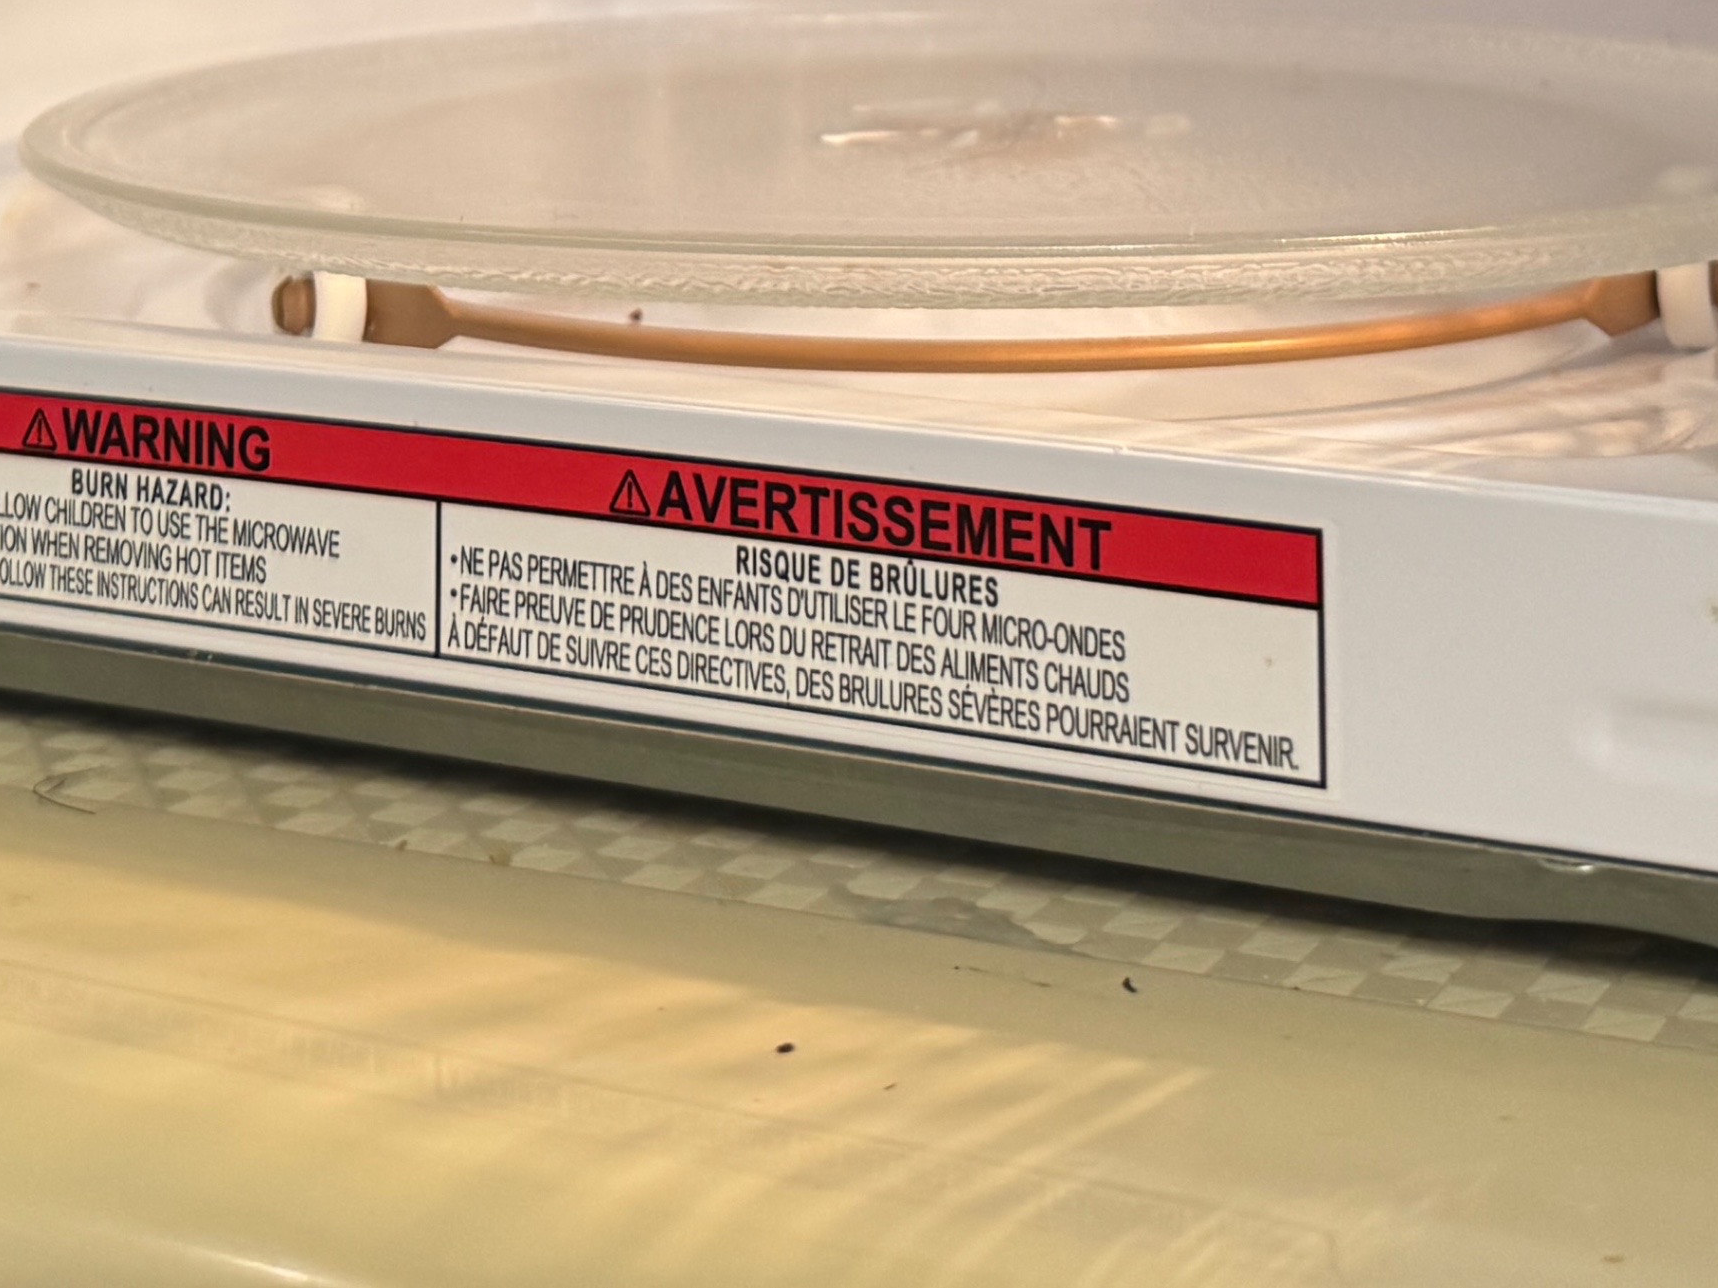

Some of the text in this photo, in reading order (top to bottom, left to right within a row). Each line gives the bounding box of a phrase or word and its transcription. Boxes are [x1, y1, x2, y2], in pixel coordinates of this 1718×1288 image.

[62, 407, 270, 473] WARNING
[70, 467, 231, 514] BURN HAZARD:
[656, 470, 1112, 572] AVERTISSEMENT
[44, 495, 127, 533] CHILDREN
[129, 505, 154, 538] TO
[157, 508, 192, 542] USE
[194, 513, 229, 546] THE
[232, 517, 340, 560] MICROWAVE
[460, 544, 1127, 663] NE PAS PERMETTRE À DES ENFANTS D'UTILISER LE FOUR MICRO-ONDES
[736, 544, 1000, 609] RISQUE DE BRÛLURES
[447, 611, 461, 649] À
[464, 610, 534, 660] DÉFAUT
[537, 630, 562, 664] DE
[565, 634, 632, 673] SUIVRE
[635, 643, 673, 680] CES
[677, 649, 790, 700] DIRECTIVES,
[795, 665, 835, 703] DES
[947, 682, 1042, 733] SÉVÈRES
[1045, 701, 1181, 754] POURRAIENT
[1184, 722, 1300, 771] SURVENIR.
